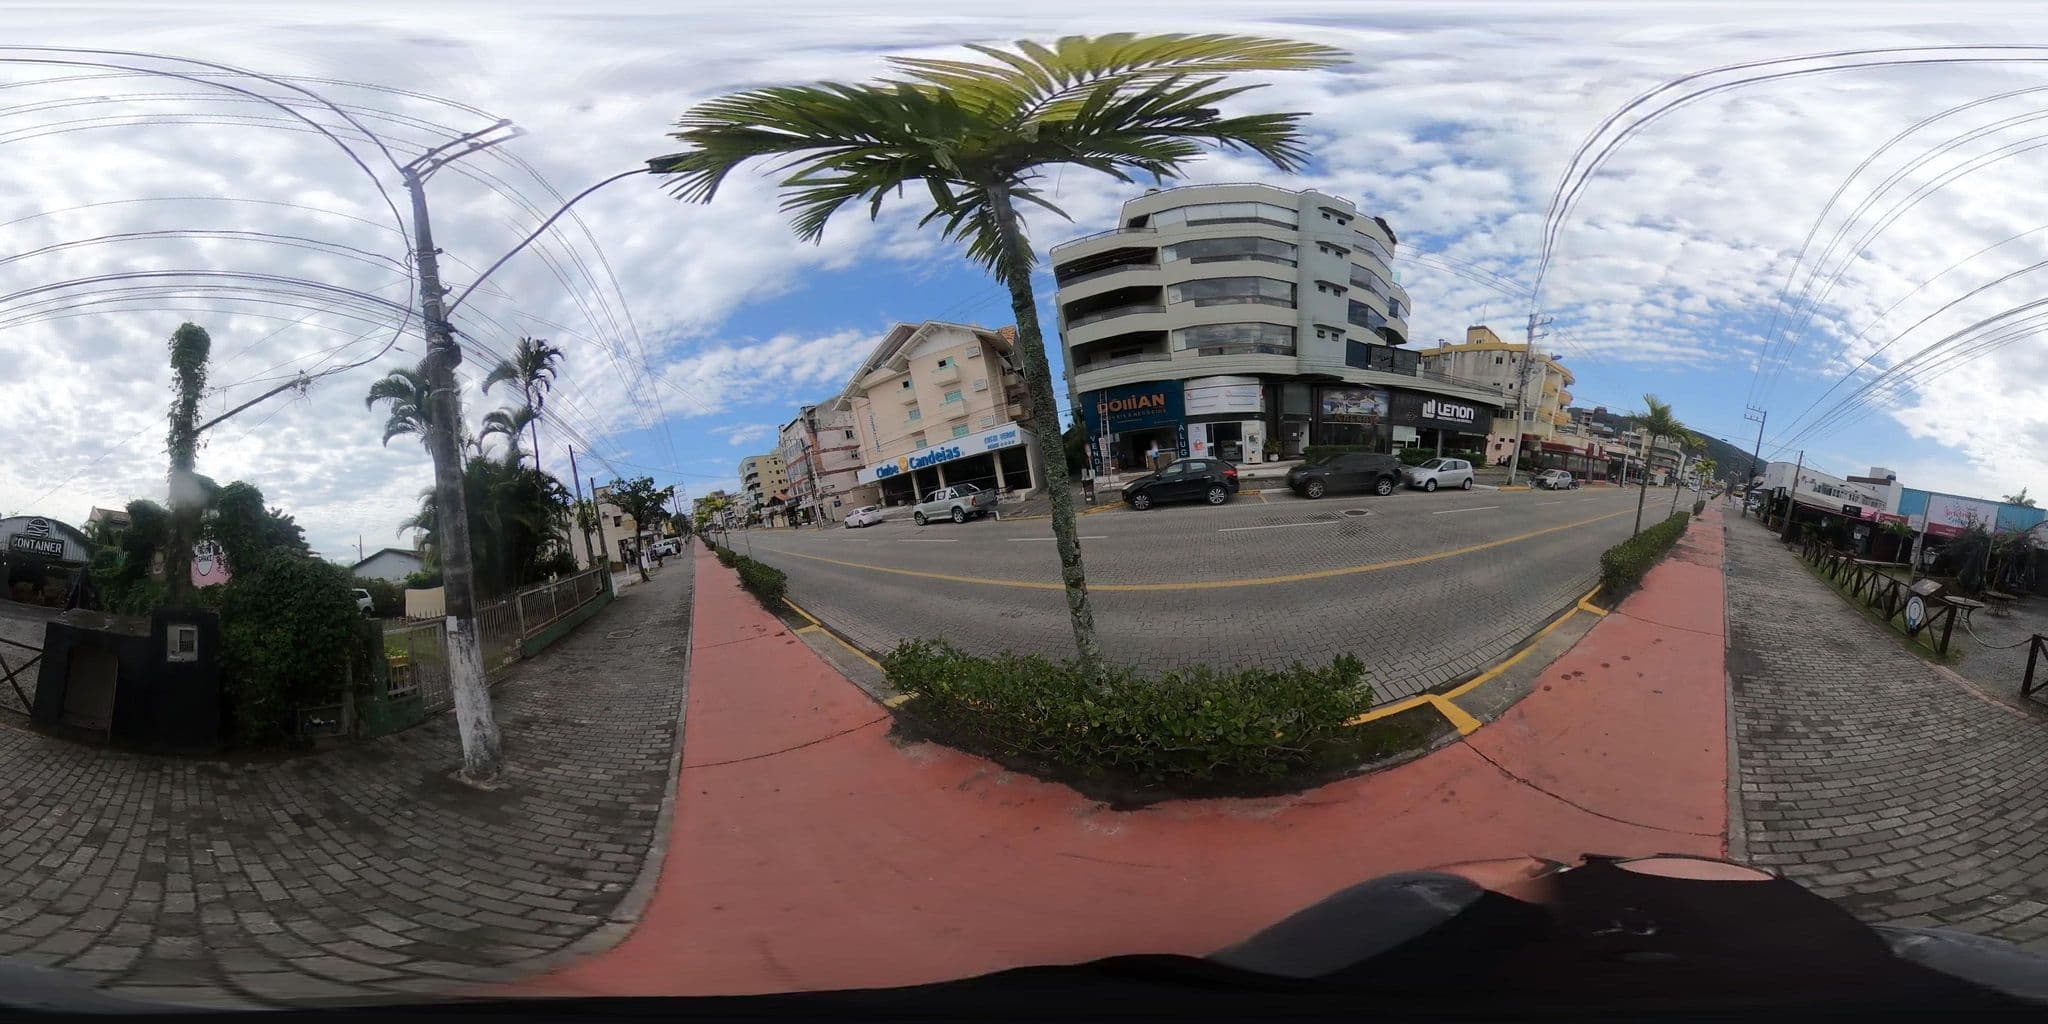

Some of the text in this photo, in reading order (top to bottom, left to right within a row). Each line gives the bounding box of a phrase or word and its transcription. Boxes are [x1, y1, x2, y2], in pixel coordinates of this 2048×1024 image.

[1437, 402, 1474, 420] LENON
[876, 446, 961, 478] Clube Candeias
